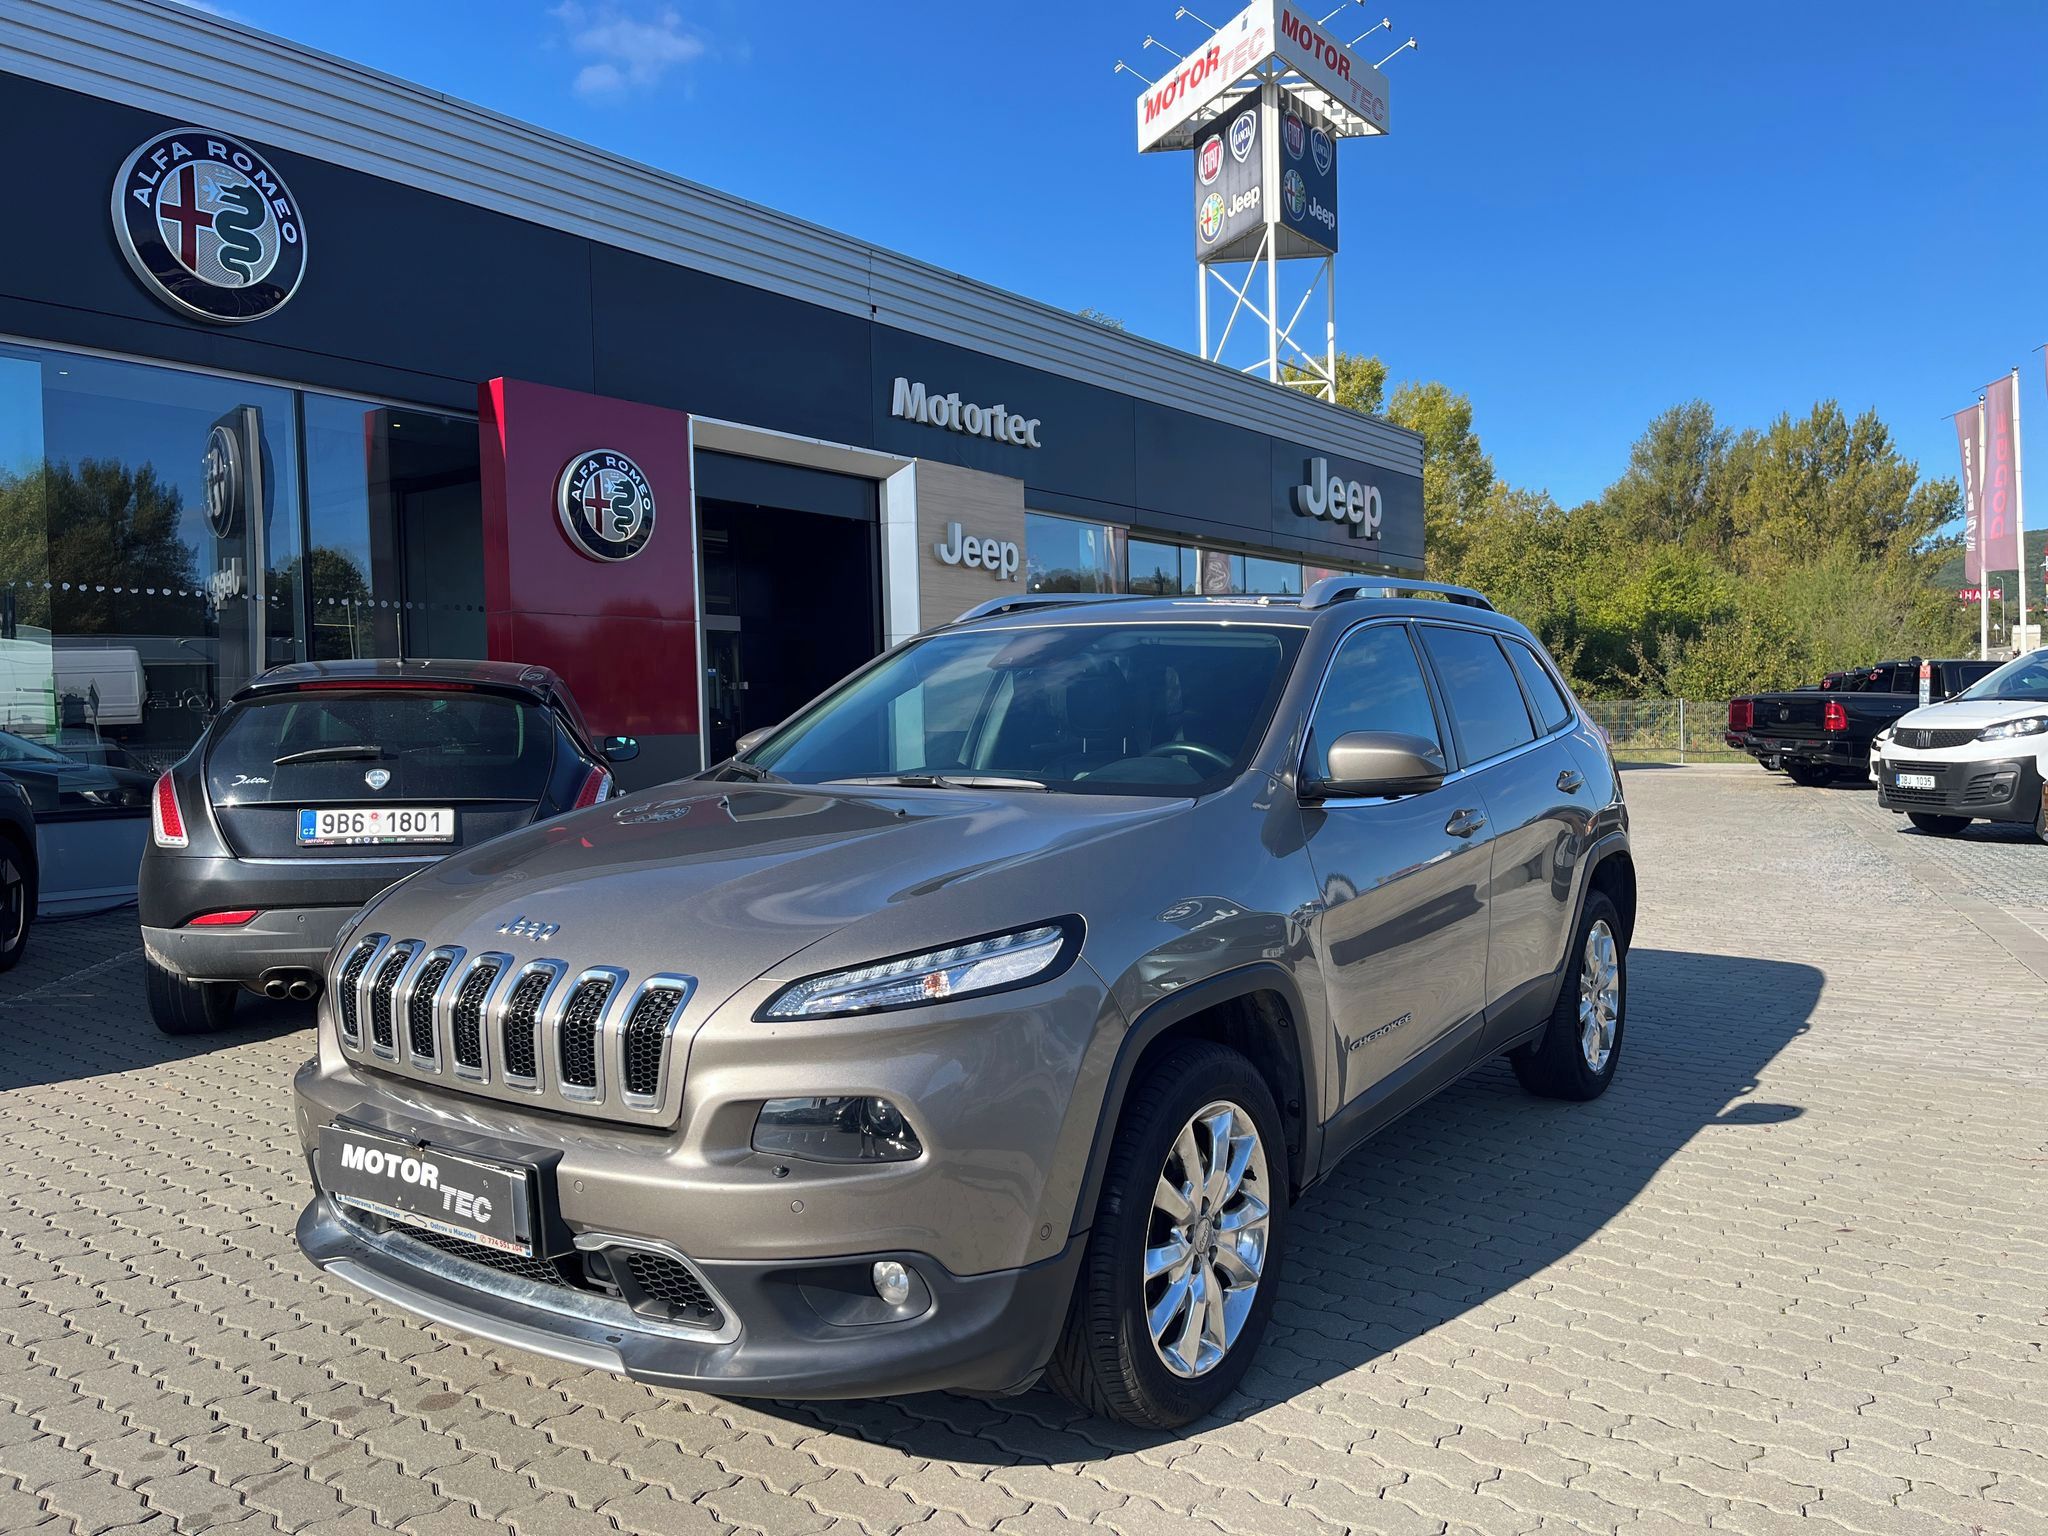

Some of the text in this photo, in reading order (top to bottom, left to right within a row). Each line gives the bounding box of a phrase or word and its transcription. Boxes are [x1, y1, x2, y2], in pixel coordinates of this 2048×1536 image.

[1145, 26, 1266, 125] MOTOR TEC
[1281, 8, 1385, 122] MOTOR TEC
[1235, 125, 1251, 145] LANCIA
[1288, 122, 1301, 149] FIAT
[1204, 146, 1219, 175] FIAT
[133, 140, 298, 244] ALFA ROMEO
[1227, 185, 1260, 218] Jeep
[1308, 197, 1336, 230] Jeep
[891, 377, 1042, 448] Motortec
[571, 456, 651, 511] ALFA ROMEO
[1297, 456, 1383, 537] Jeep
[934, 522, 1020, 581] Jeep
[321, 811, 440, 834] 9B6 1801
[496, 912, 560, 942] Jeep
[1349, 1011, 1412, 1052] CHEROKEE
[341, 1142, 493, 1224] MOTOR TEC
